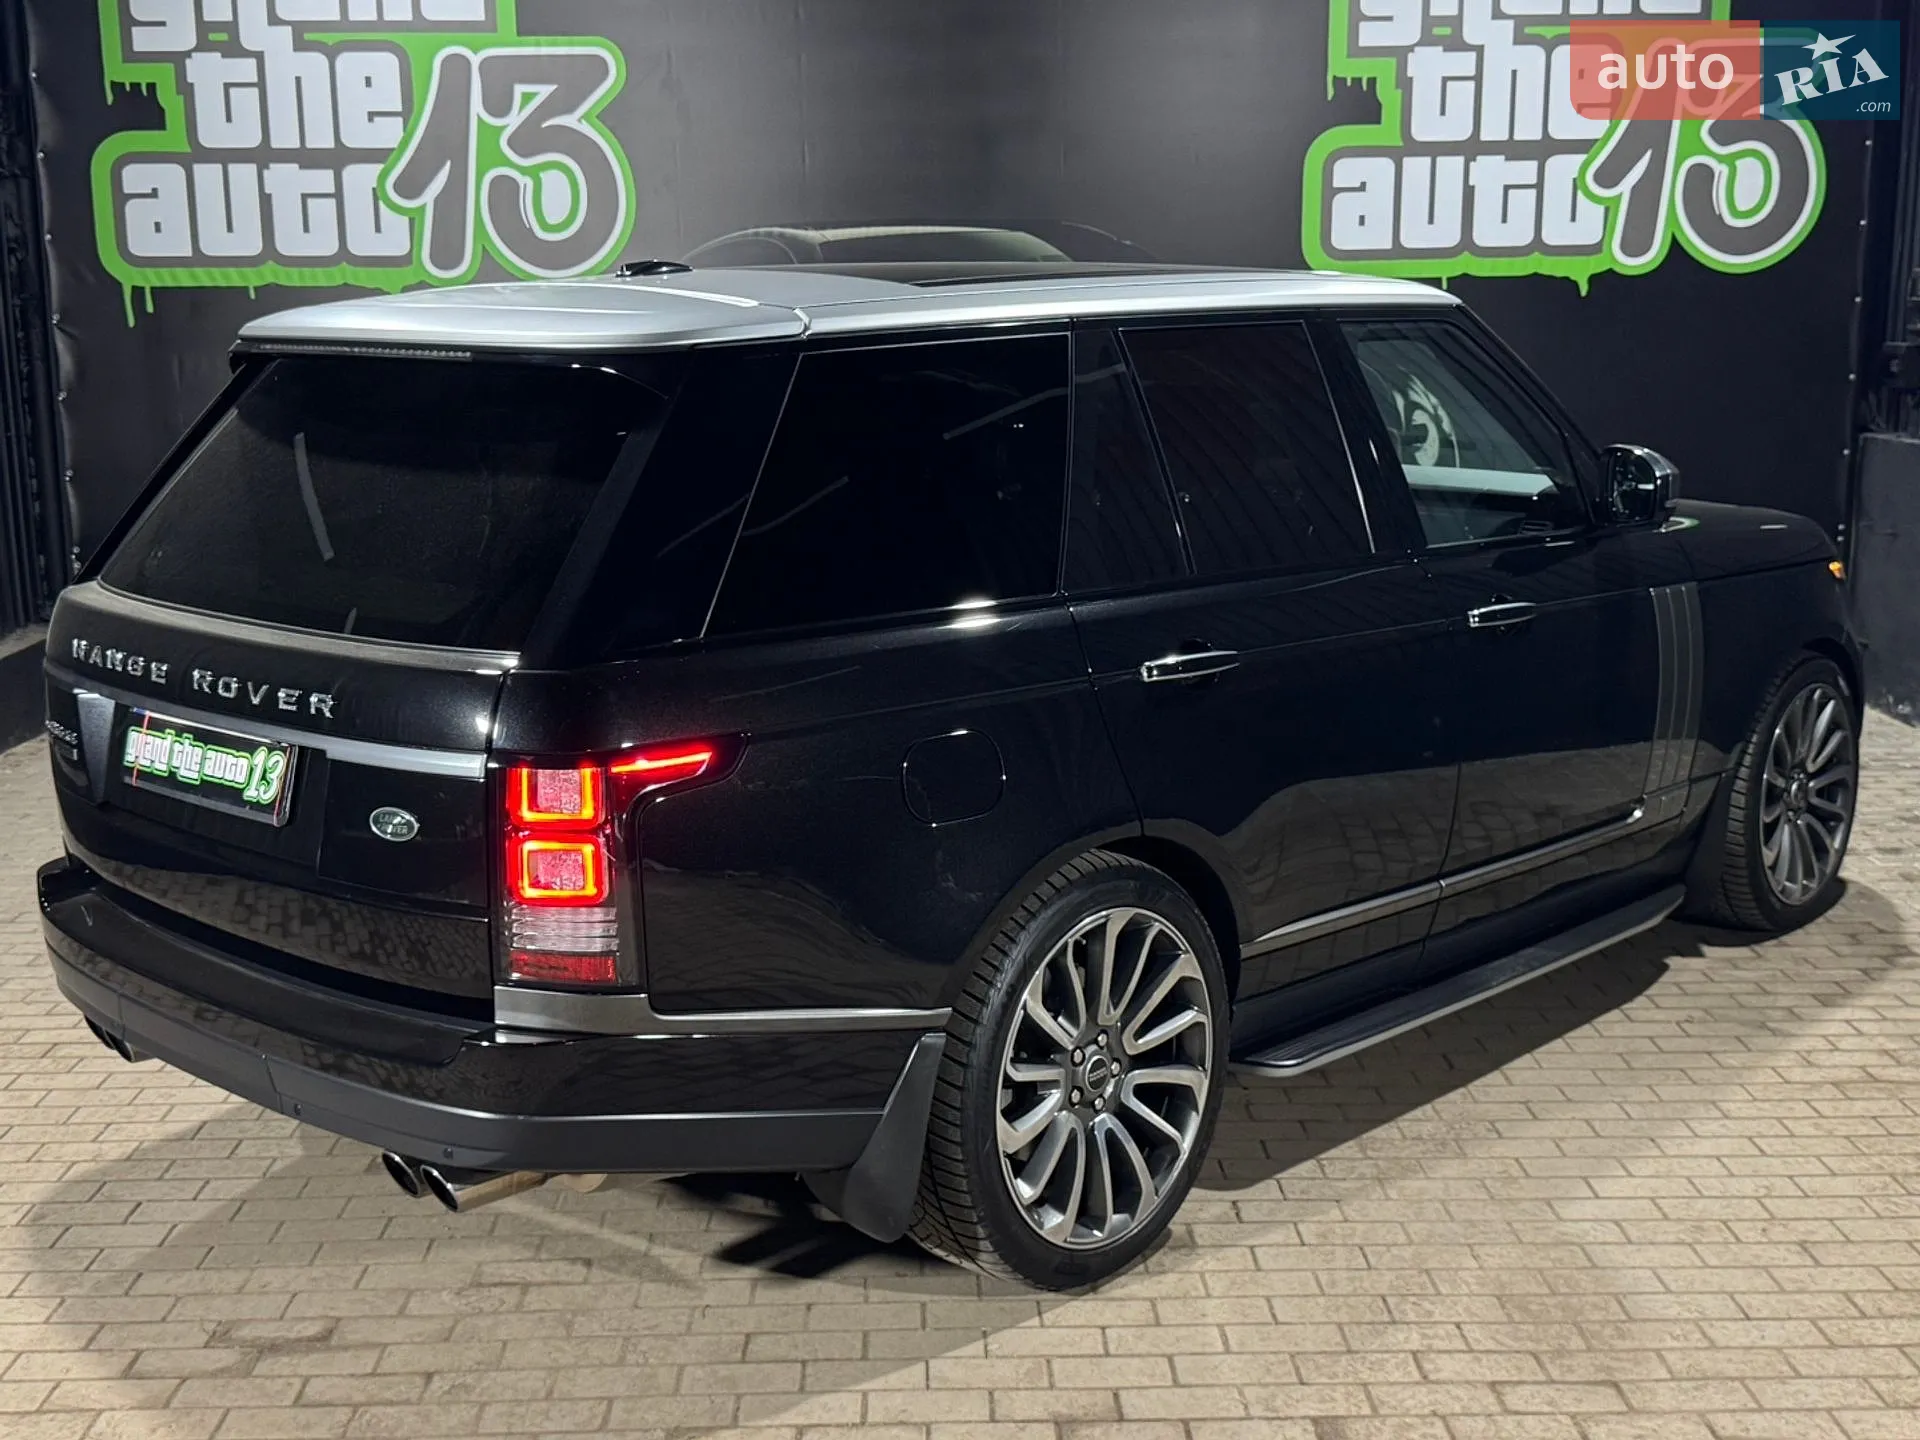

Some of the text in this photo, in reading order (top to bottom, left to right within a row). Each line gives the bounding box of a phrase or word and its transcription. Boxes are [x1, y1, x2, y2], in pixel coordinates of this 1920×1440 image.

[186, 0, 404, 149] the
[1406, 0, 1613, 142] the
[121, 45, 628, 280] auto 13
[1331, 37, 1818, 265] auto 13
[71, 637, 336, 719] RANGE ROVER
[125, 729, 173, 772] grand
[203, 749, 249, 784] auto
[244, 747, 285, 803] 13
